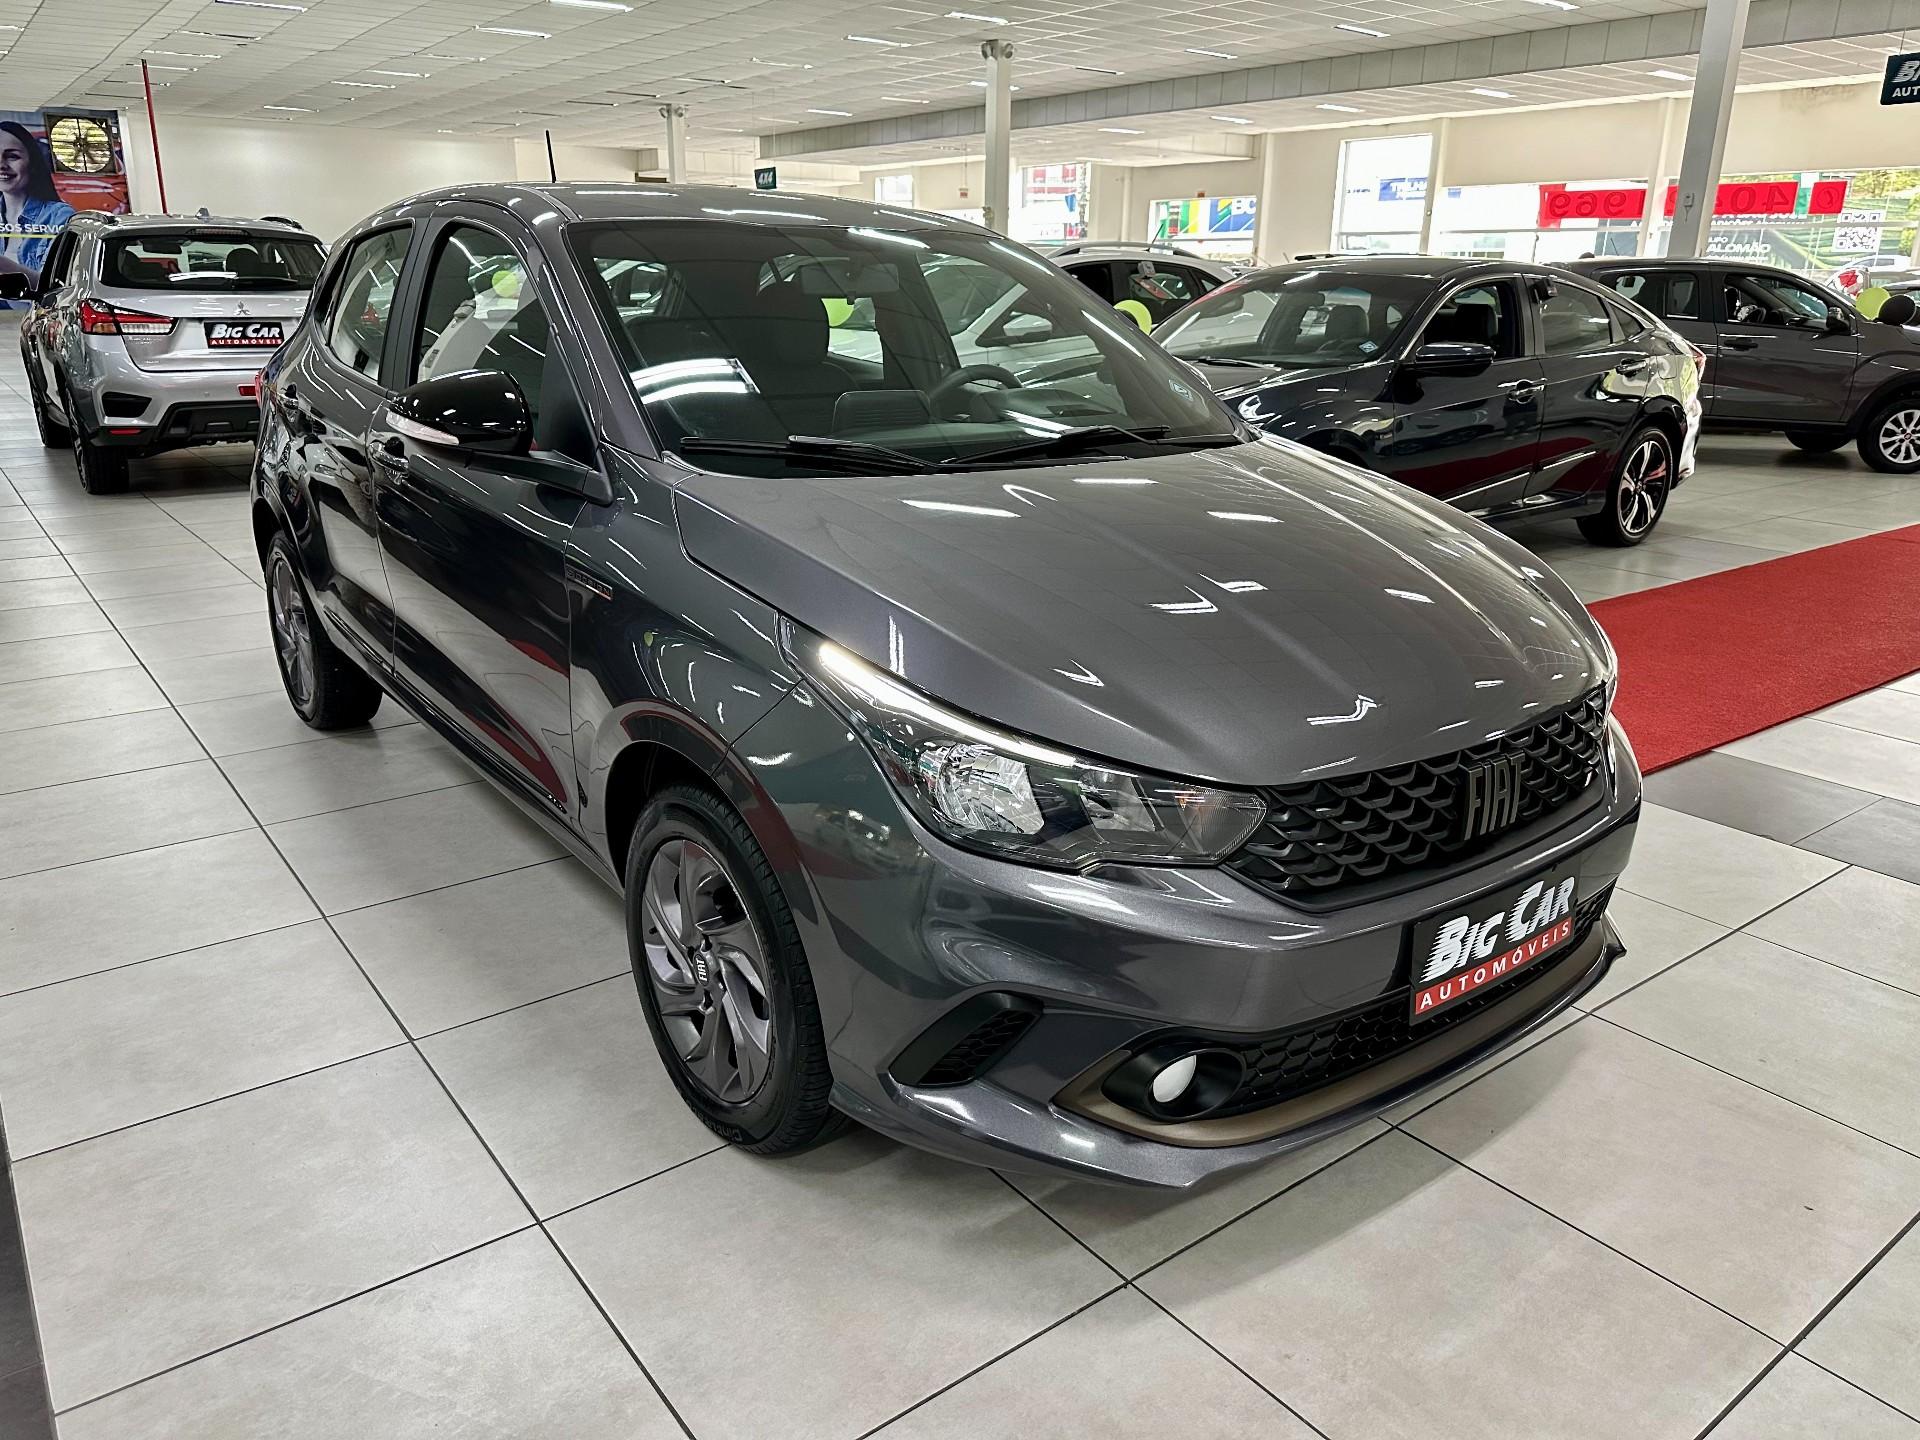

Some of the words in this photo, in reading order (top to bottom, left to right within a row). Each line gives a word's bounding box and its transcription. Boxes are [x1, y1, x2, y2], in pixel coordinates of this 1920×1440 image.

[210, 324, 244, 339] BIG
[245, 324, 281, 339] CAR
[1463, 752, 1526, 841] FIAT
[696, 958, 708, 982] FIAT
[1418, 910, 1505, 983] BIG
[1504, 876, 1575, 943] CAR
[1419, 920, 1570, 1010] AUTOMÓVEIS
